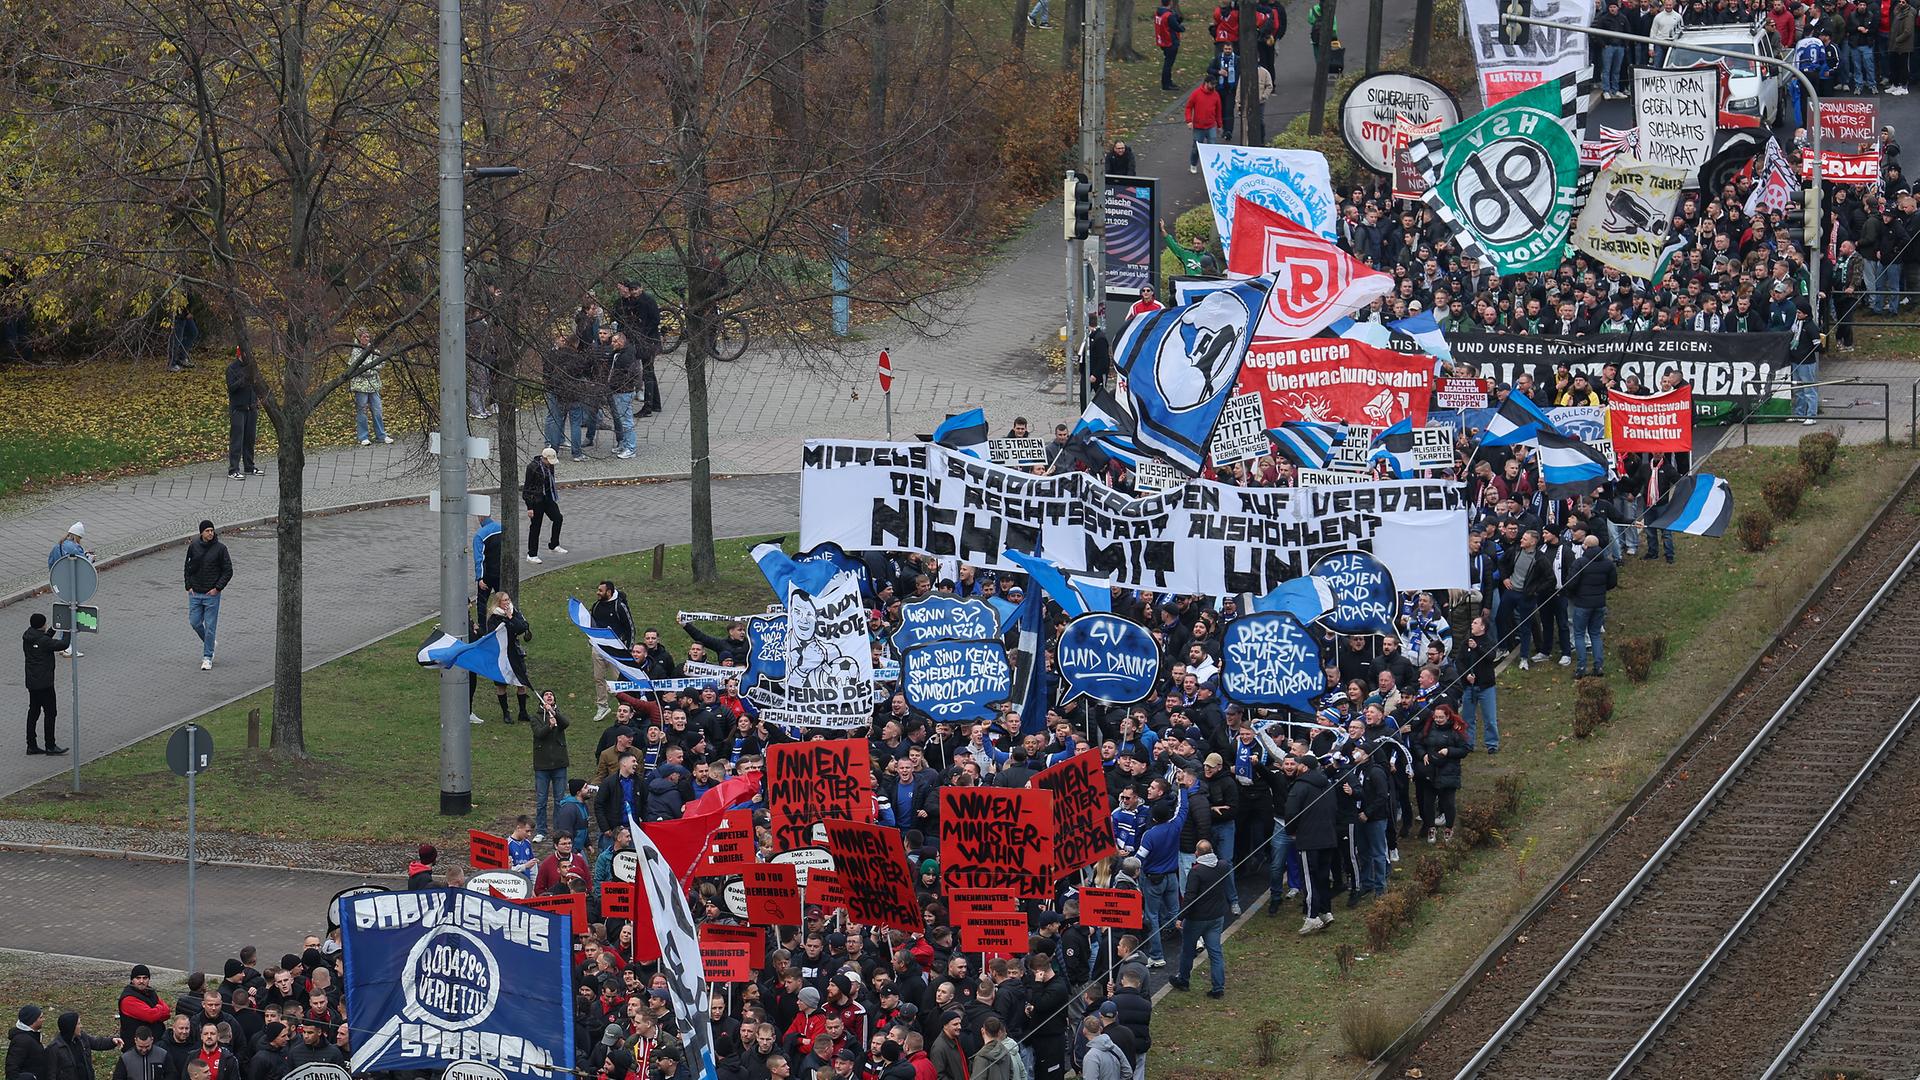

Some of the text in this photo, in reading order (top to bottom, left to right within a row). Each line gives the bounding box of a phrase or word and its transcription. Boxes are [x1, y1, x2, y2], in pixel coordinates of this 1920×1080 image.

[1489, 73, 1538, 83] ULTRAS
[1642, 75, 1704, 95] IMMER VORAN
[1367, 88, 1434, 111] SICHERHEITS-
[1642, 98, 1706, 118] GEGEN DEN
[1648, 121, 1706, 141] SICHERHEITS-
[1811, 126, 1835, 138] EIN
[1648, 141, 1698, 166] APPARAT
[1245, 343, 1350, 369] Gegen euren
[1457, 341, 1713, 355] UND UNSERE WAHRNEHMUNG ZEIGEN:
[1266, 366, 1428, 392] Überwachungswahn!
[1620, 360, 1771, 397] SICHER!
[1226, 393, 1259, 410] ENDIGE
[1438, 393, 1486, 401] POPULISMUS
[1446, 400, 1481, 408] STOPPEN
[1610, 400, 1690, 413] Sicherheitswahn
[1628, 413, 1678, 426] zerstört
[1213, 433, 1266, 453] ENGLISCHE
[1622, 426, 1682, 440] Fankultur
[989, 439, 1044, 450] DIE STADIEN
[990, 449, 1045, 460] SIND SICHER!
[803, 445, 927, 470] MITTELS
[1138, 475, 1153, 486] NUR
[1154, 478, 1167, 487] MIT
[890, 471, 1384, 547] DEN RECHTSSTAAT AUSHÖHLEN?
[1238, 492, 1291, 520] AUF
[1085, 531, 1176, 587] MIT
[1324, 554, 1364, 573] DIE
[1337, 586, 1369, 599] IND
[907, 607, 945, 623] WENN
[815, 614, 866, 640] GROTE
[910, 625, 952, 640] DANN
[1089, 621, 1128, 646] SV
[1237, 618, 1303, 645] DREI-
[908, 645, 999, 670] WIR SIND KEIN
[1227, 640, 1316, 664] STUFEN-
[1062, 647, 1155, 678] UND DANN?
[1239, 659, 1296, 678] PLAN
[908, 661, 1009, 685] SPIELBALL EURER
[788, 679, 872, 702] FEIND DES
[907, 676, 1010, 703] SYMBOLPOLITIK
[1223, 671, 1324, 696] VERHINDERN!
[764, 711, 822, 725] POPULISMUS
[777, 747, 863, 780] INNEN-
[772, 775, 872, 805] MINISTER-
[782, 800, 853, 824] WAHN
[943, 821, 1049, 852] MINISTER-
[957, 843, 1025, 867] WAHN
[755, 872, 783, 882] DO YOU
[944, 864, 1053, 896] STOPPEN!
[746, 887, 789, 897] REMEMBER
[954, 894, 1013, 902] INNENMINISTER-
[967, 918, 1026, 927] INNENMINISTER-
[984, 928, 1005, 936] WAHN
[977, 938, 1009, 946] STOPPEN
[705, 959, 728, 967] WAHN
[419, 976, 487, 1016] VERLETZTE
[400, 1022, 553, 1079] STOPPEN!
